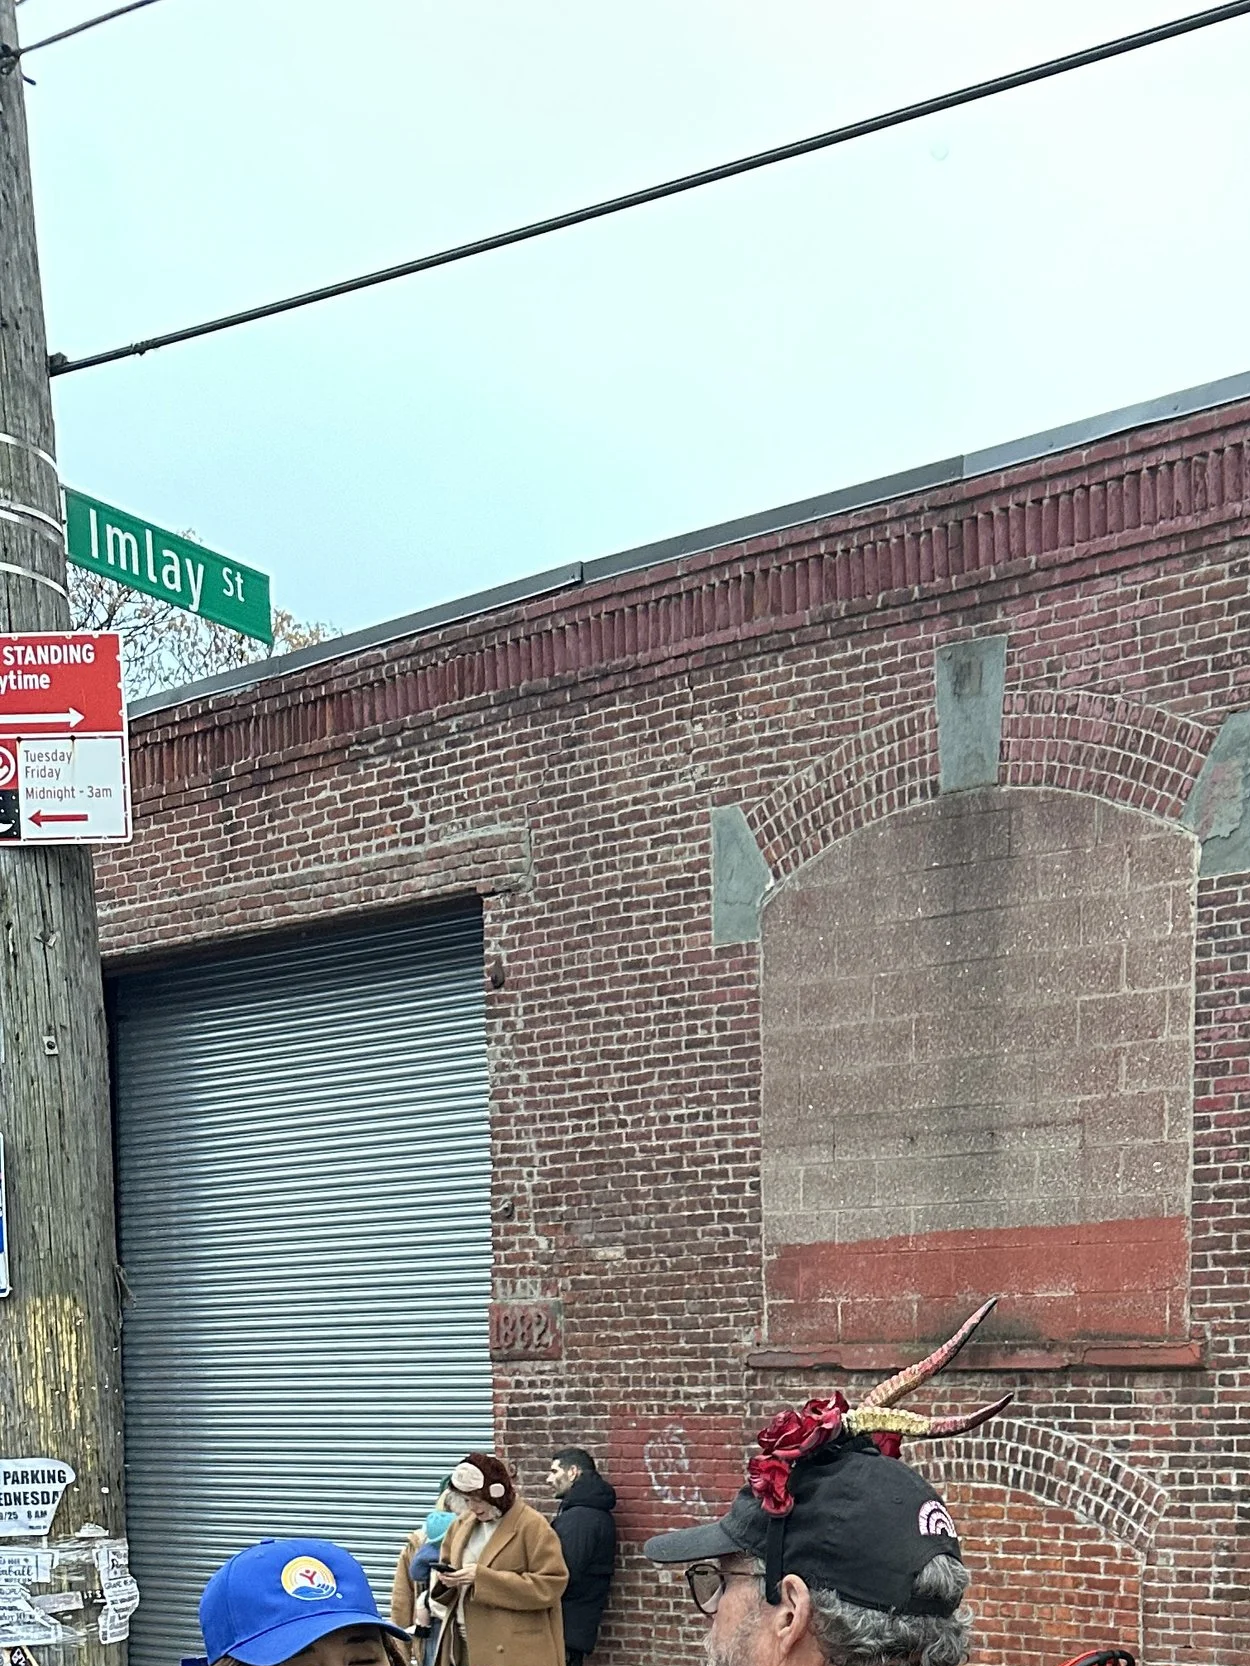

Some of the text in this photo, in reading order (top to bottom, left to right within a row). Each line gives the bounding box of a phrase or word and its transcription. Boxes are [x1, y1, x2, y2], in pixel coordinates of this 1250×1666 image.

[89, 509, 204, 612] Imlay
[3, 644, 95, 666] STANDING
[24, 749, 73, 766] Tuesday
[25, 765, 61, 782] Friday
[25, 786, 76, 803] Midnight
[87, 785, 112, 799] 3am
[3, 1469, 67, 1485] PARKING
